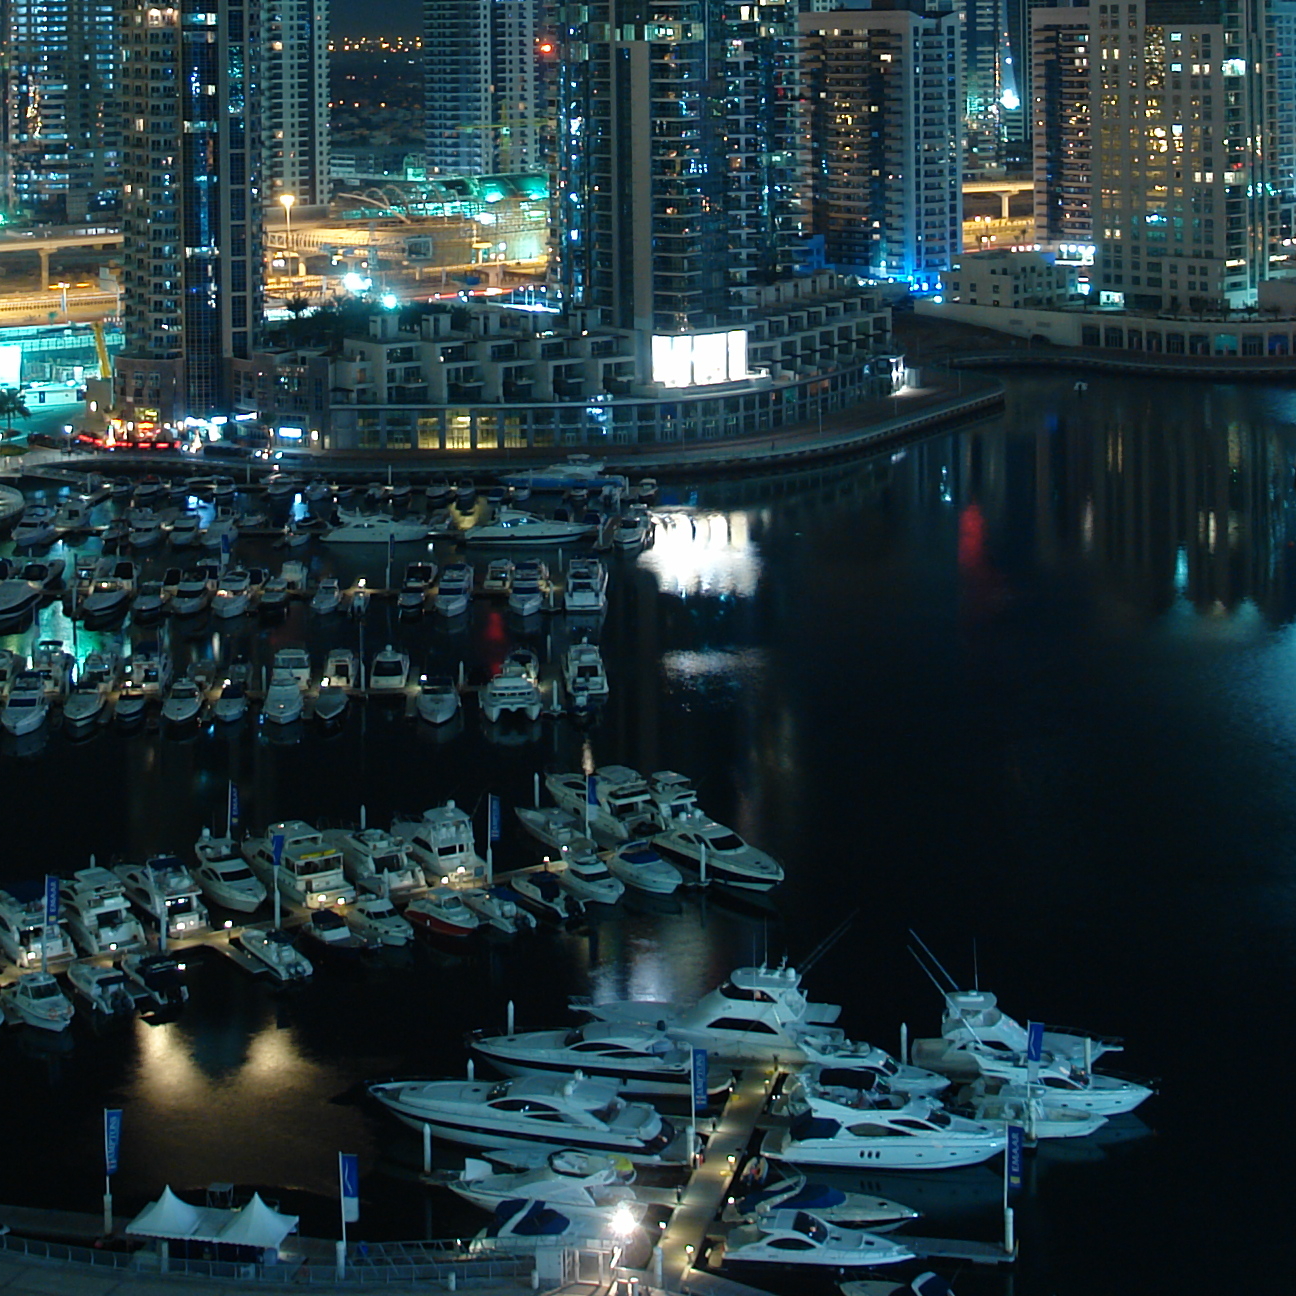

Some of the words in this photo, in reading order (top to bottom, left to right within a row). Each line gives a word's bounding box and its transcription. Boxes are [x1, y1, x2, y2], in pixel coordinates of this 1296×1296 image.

[49, 881, 57, 913] EMAAR
[695, 1053, 707, 1105] HAMPTONS
[107, 1116, 120, 1169] HAMPTONS
[1011, 1132, 1020, 1173] EMAAR
